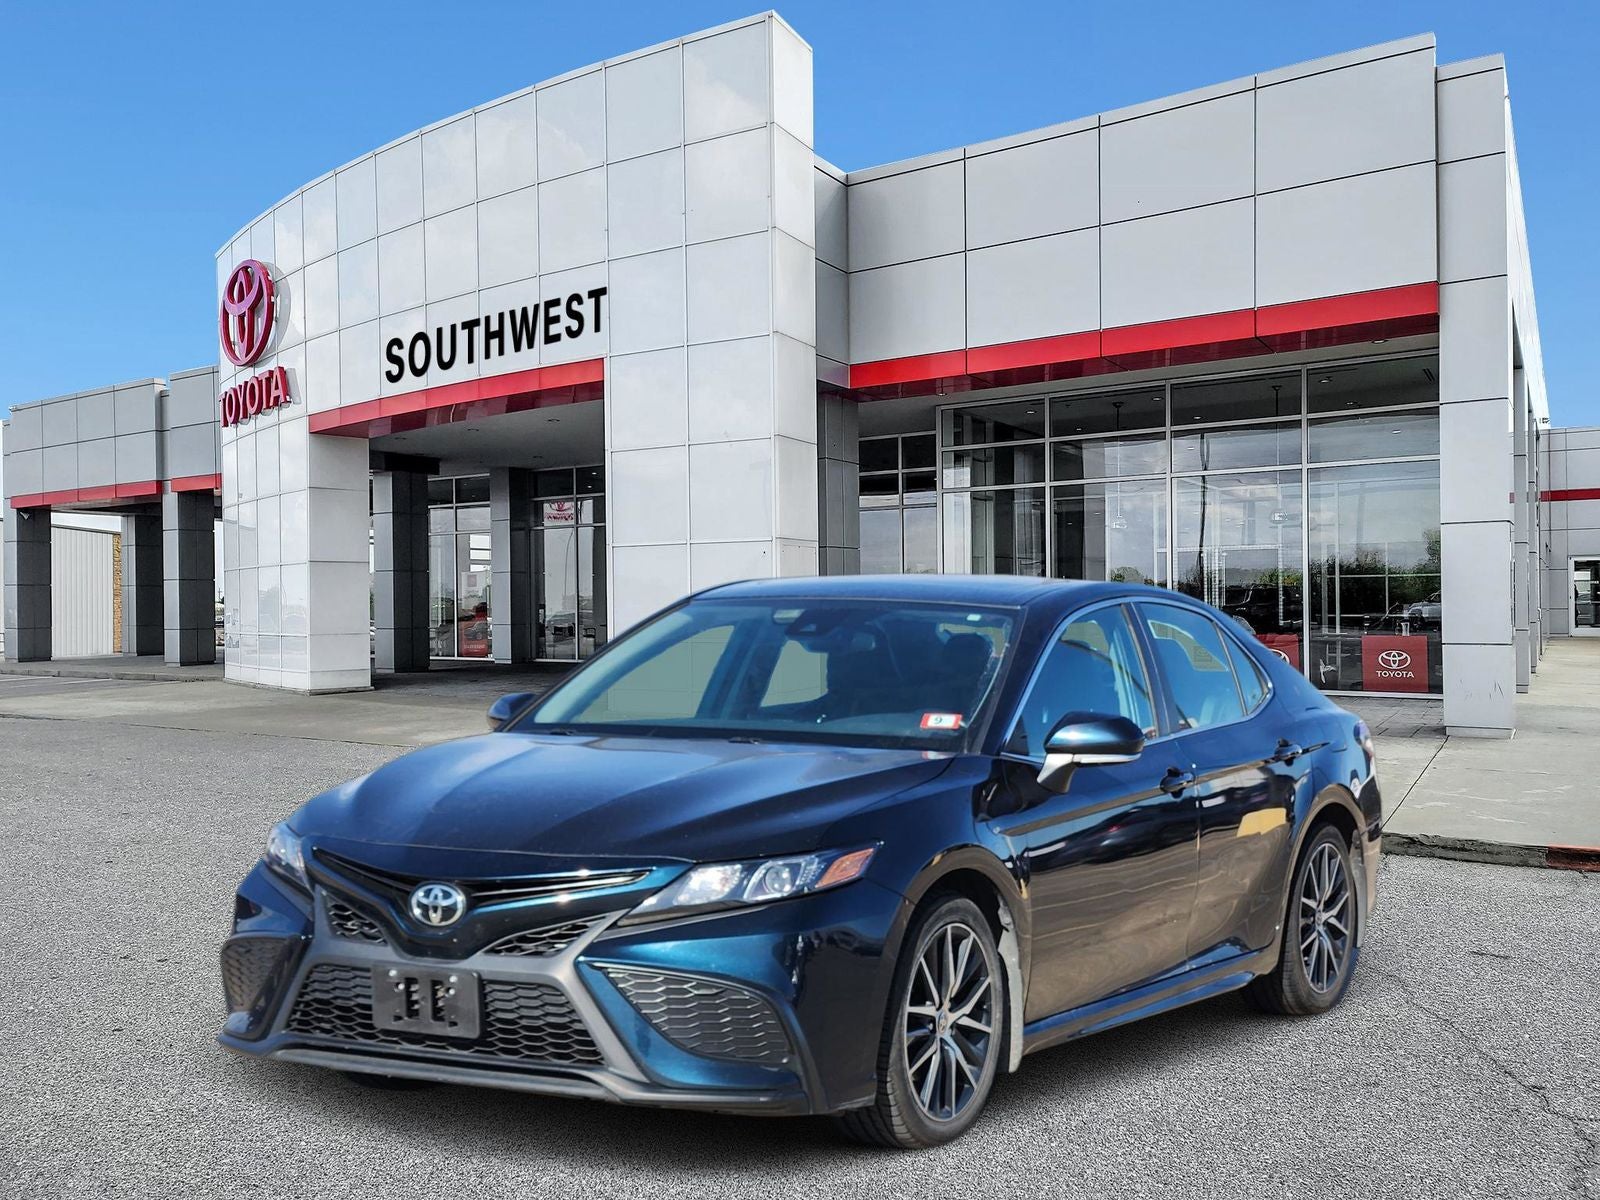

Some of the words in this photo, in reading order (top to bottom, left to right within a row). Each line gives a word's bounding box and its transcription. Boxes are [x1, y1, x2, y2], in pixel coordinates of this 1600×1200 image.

[385, 286, 608, 384] SOUTHWEST
[219, 366, 291, 427] TOYOTA
[1376, 670, 1414, 678] TOYOTA
